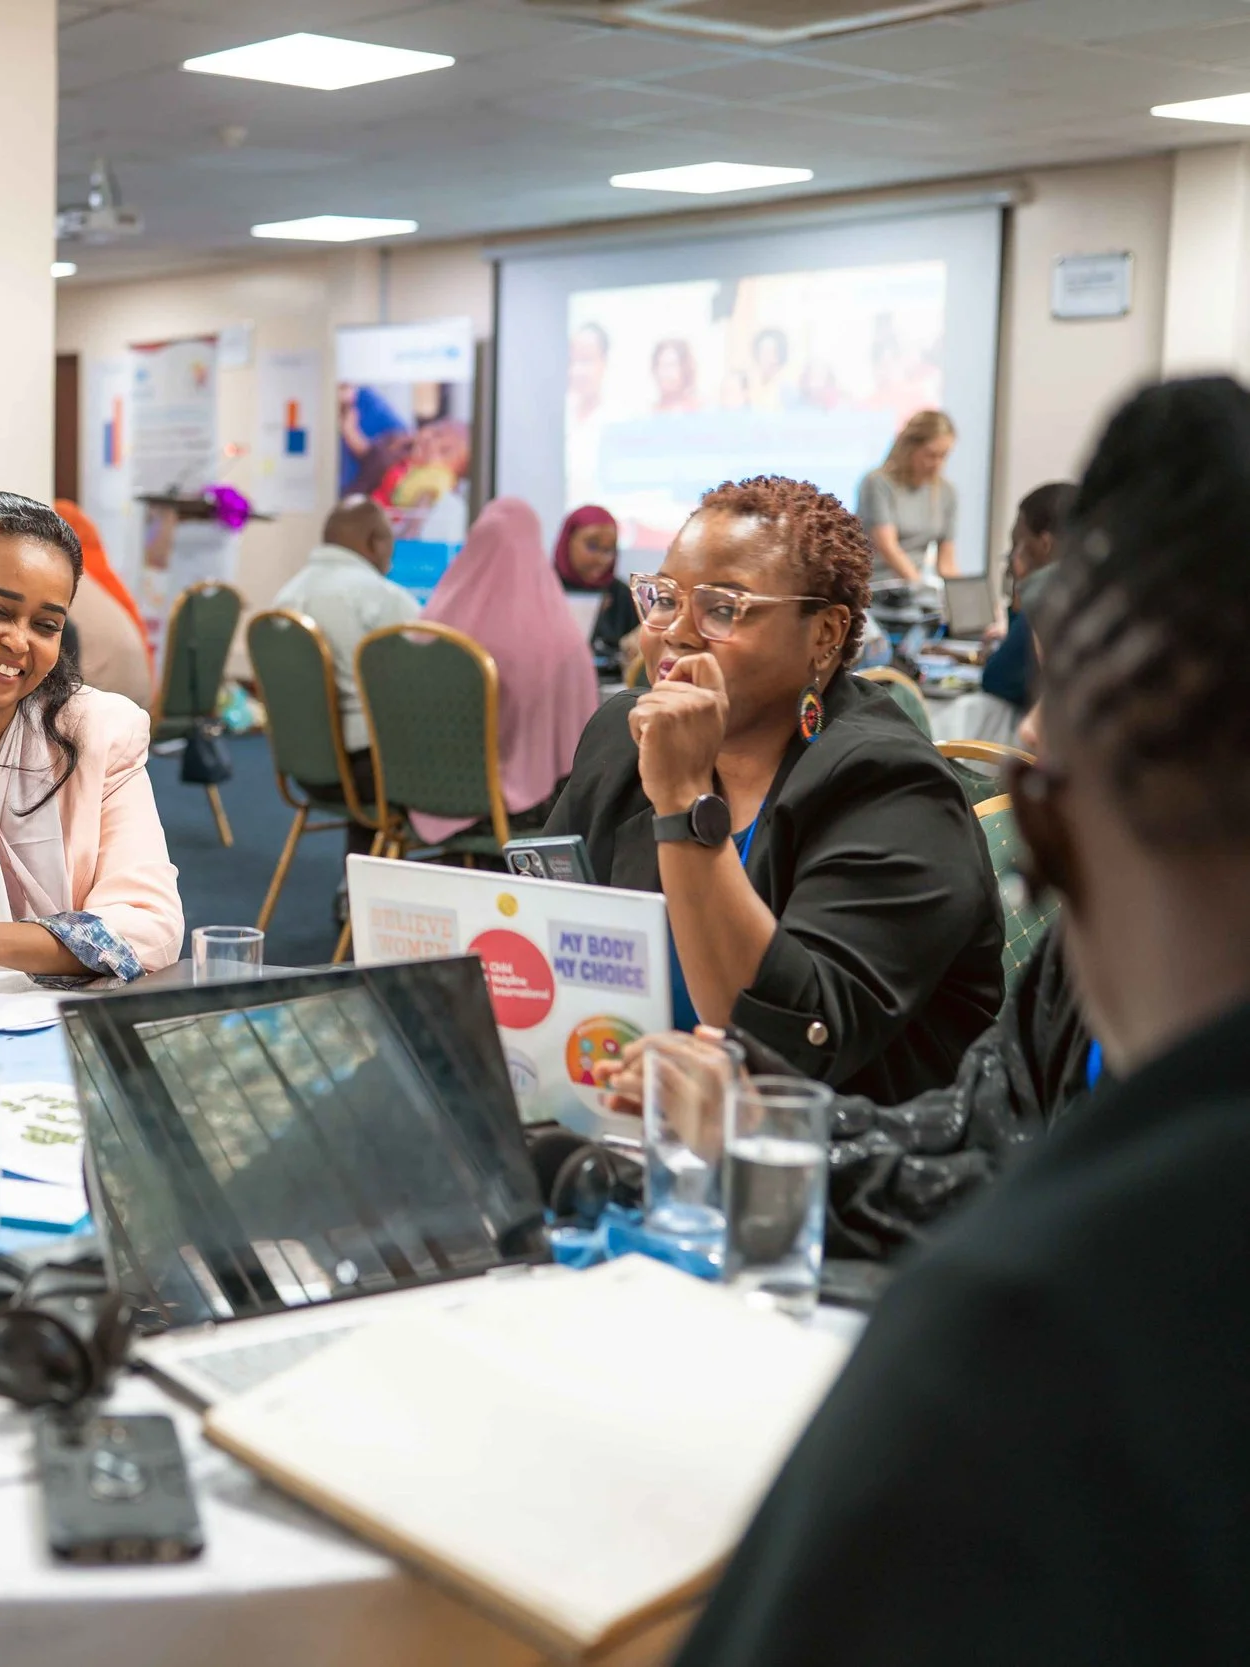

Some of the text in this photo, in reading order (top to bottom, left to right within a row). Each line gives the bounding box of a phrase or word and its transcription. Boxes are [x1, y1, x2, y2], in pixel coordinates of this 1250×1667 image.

[559, 930, 635, 962] MY BODY
[553, 956, 645, 989] MY CHOICE
